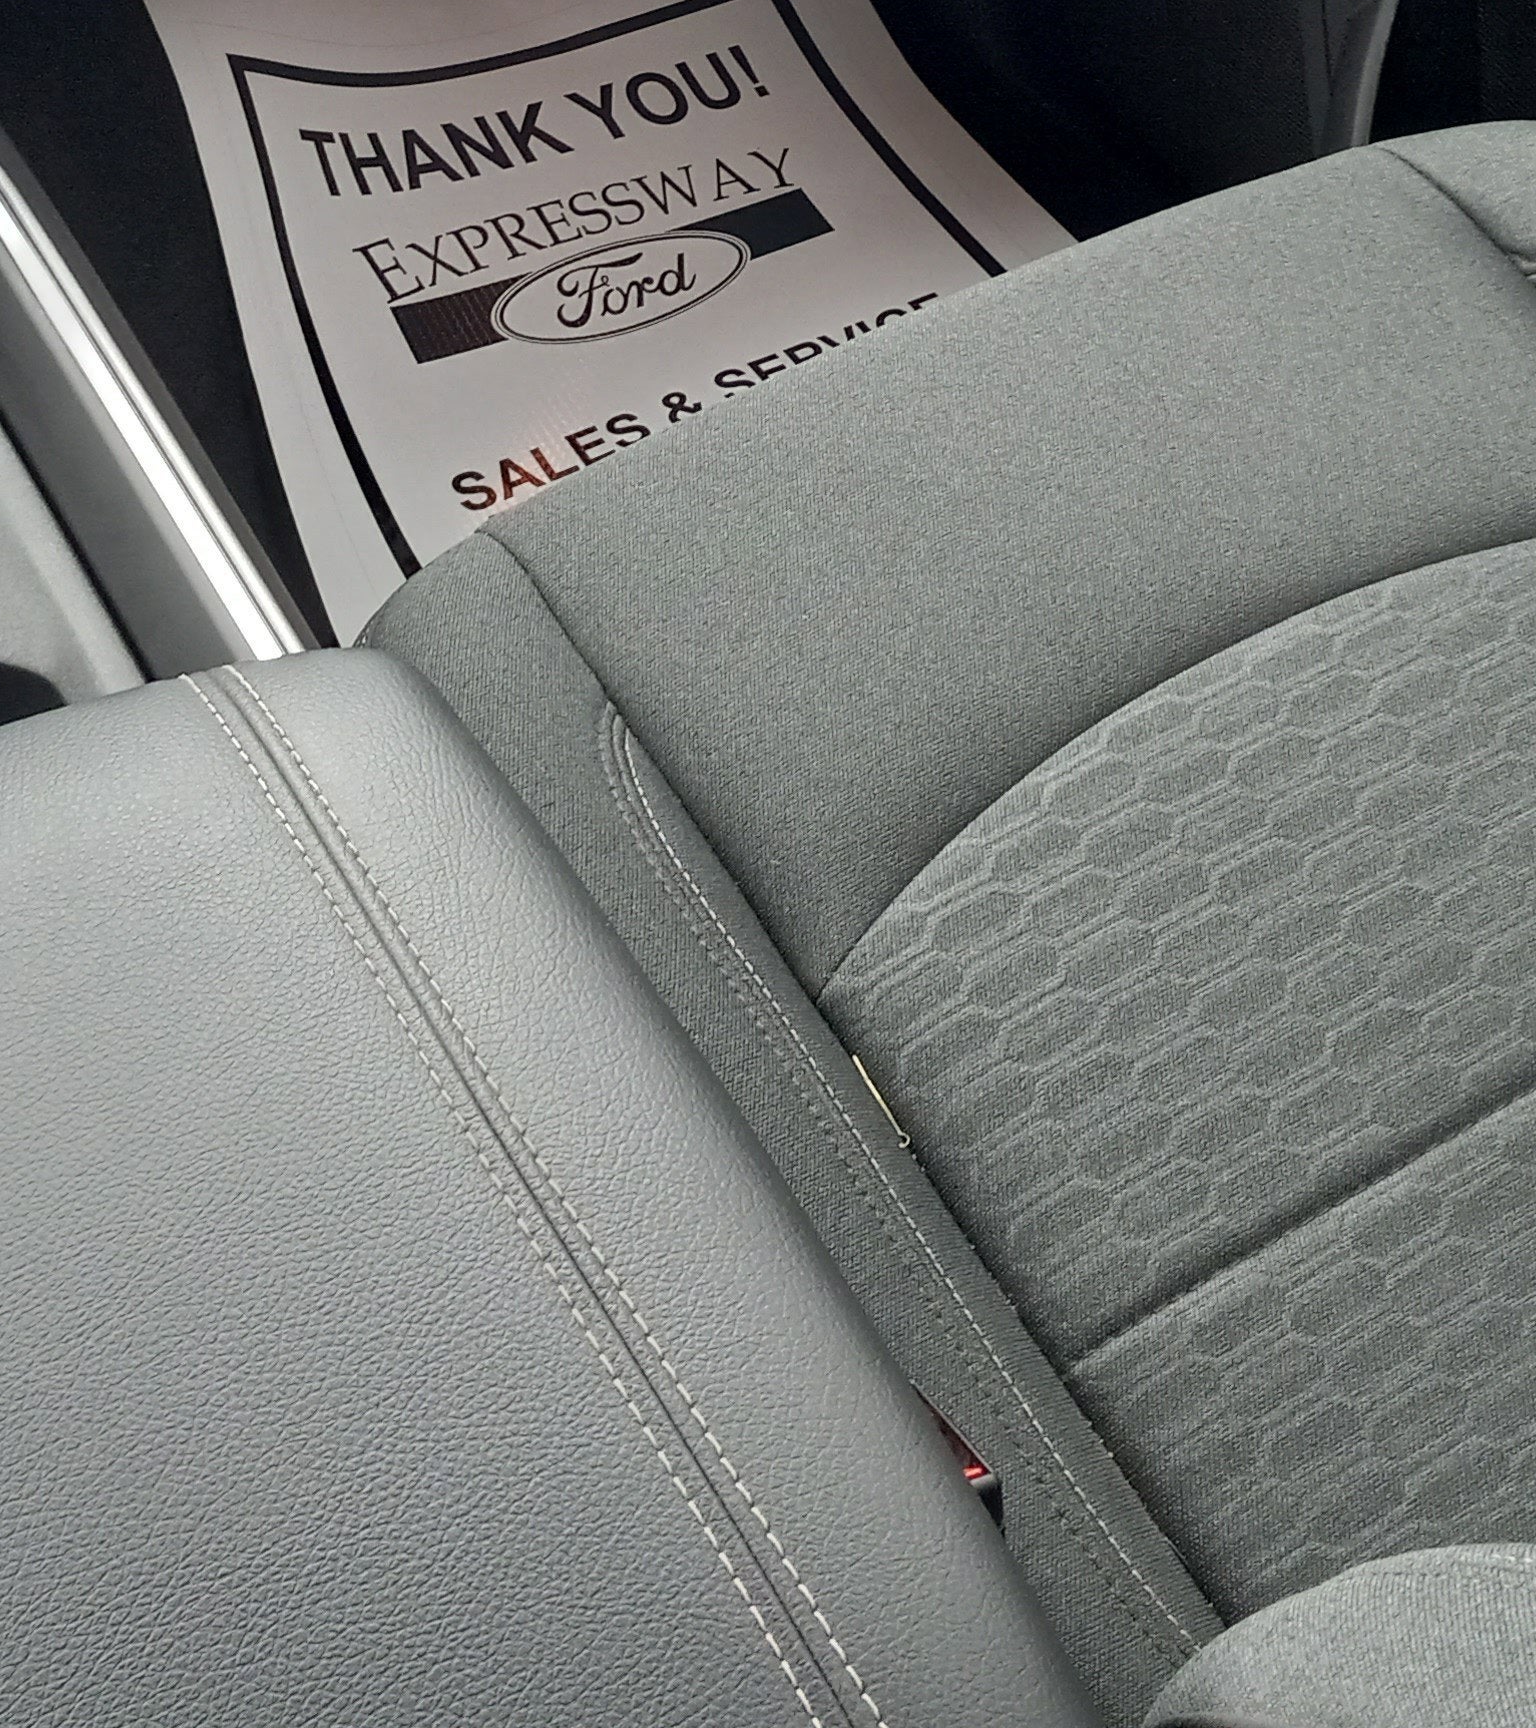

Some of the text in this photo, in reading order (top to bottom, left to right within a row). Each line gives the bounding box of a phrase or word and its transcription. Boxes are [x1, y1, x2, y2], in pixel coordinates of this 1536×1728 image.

[299, 45, 770, 197] THANK YOU!
[353, 148, 796, 305] EXPRESSWAY
[556, 253, 697, 329] Ford
[451, 413, 651, 512] SALES
[662, 391, 703, 423] &
